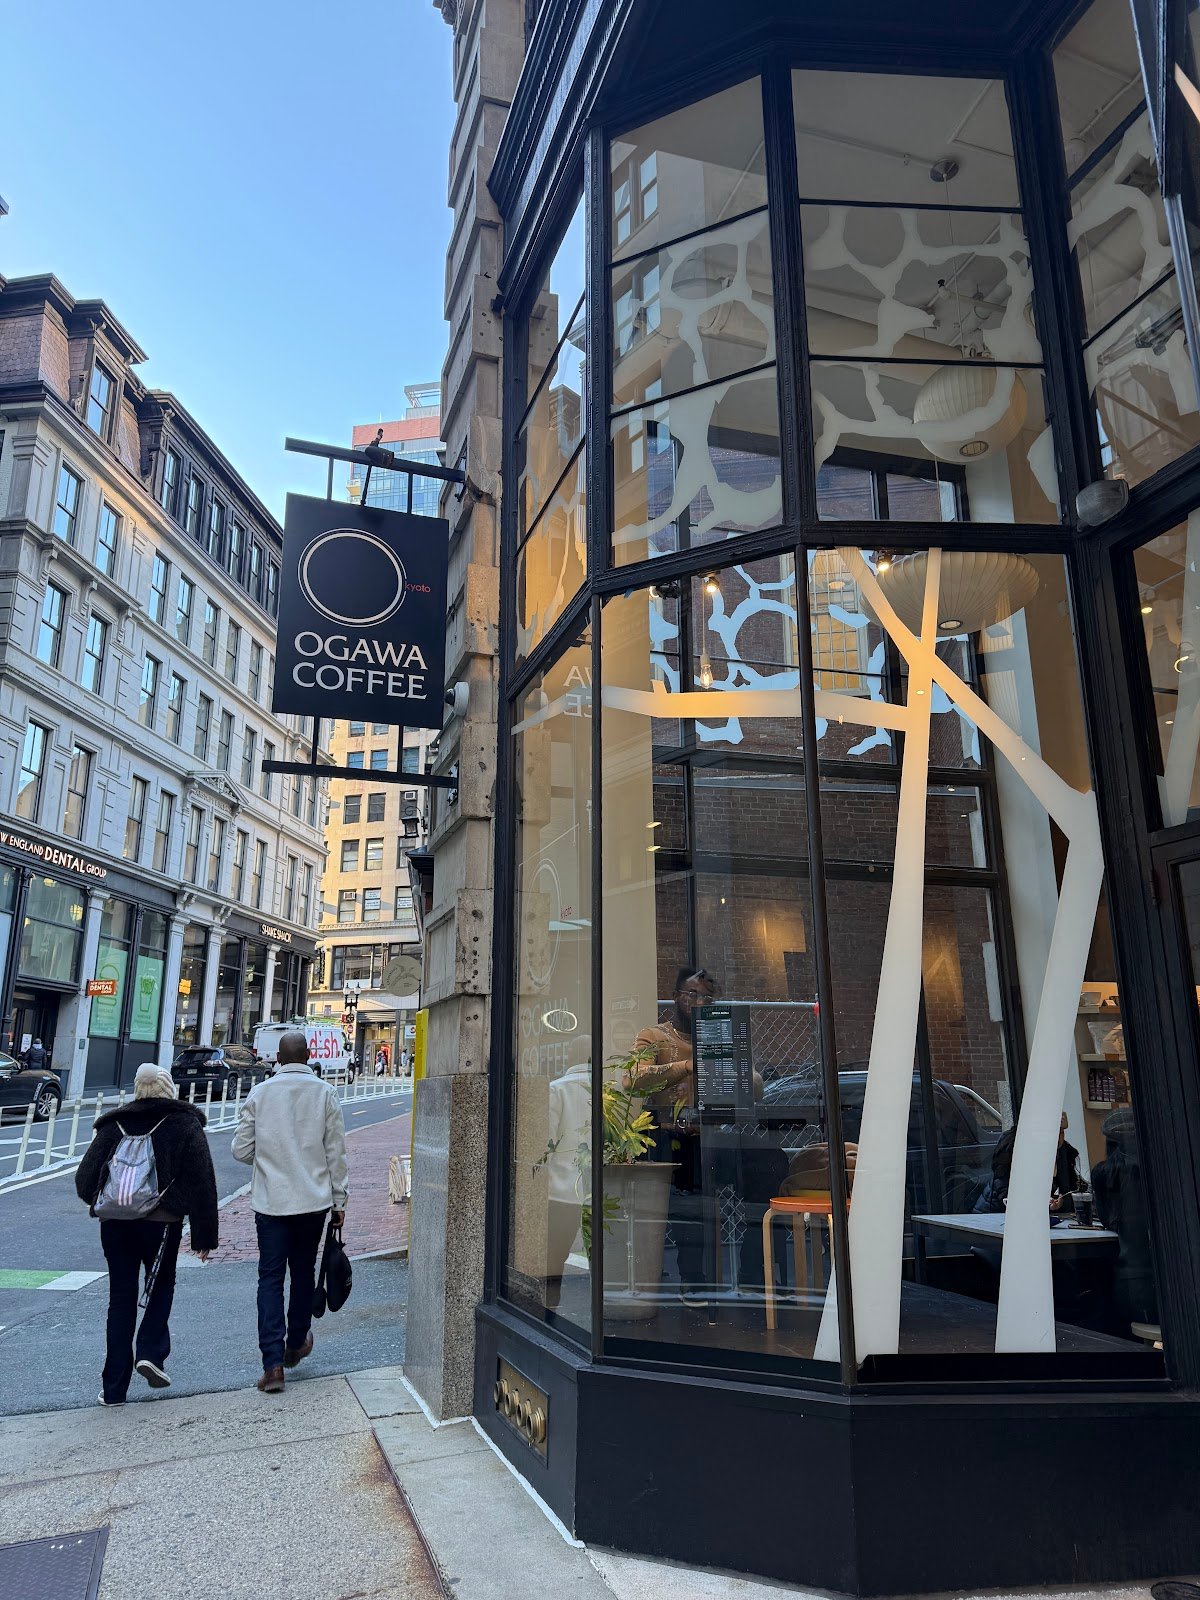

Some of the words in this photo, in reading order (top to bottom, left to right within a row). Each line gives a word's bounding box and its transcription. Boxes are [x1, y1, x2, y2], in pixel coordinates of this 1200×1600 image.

[404, 581, 431, 593] kyoto
[294, 631, 428, 670] OGAWA
[292, 661, 428, 700] COFFEE
[9, 835, 44, 856] ENGLAND
[44, 846, 86, 874] DENTAL
[86, 864, 107, 878] GROUP
[521, 1041, 570, 1080] COFFEE
